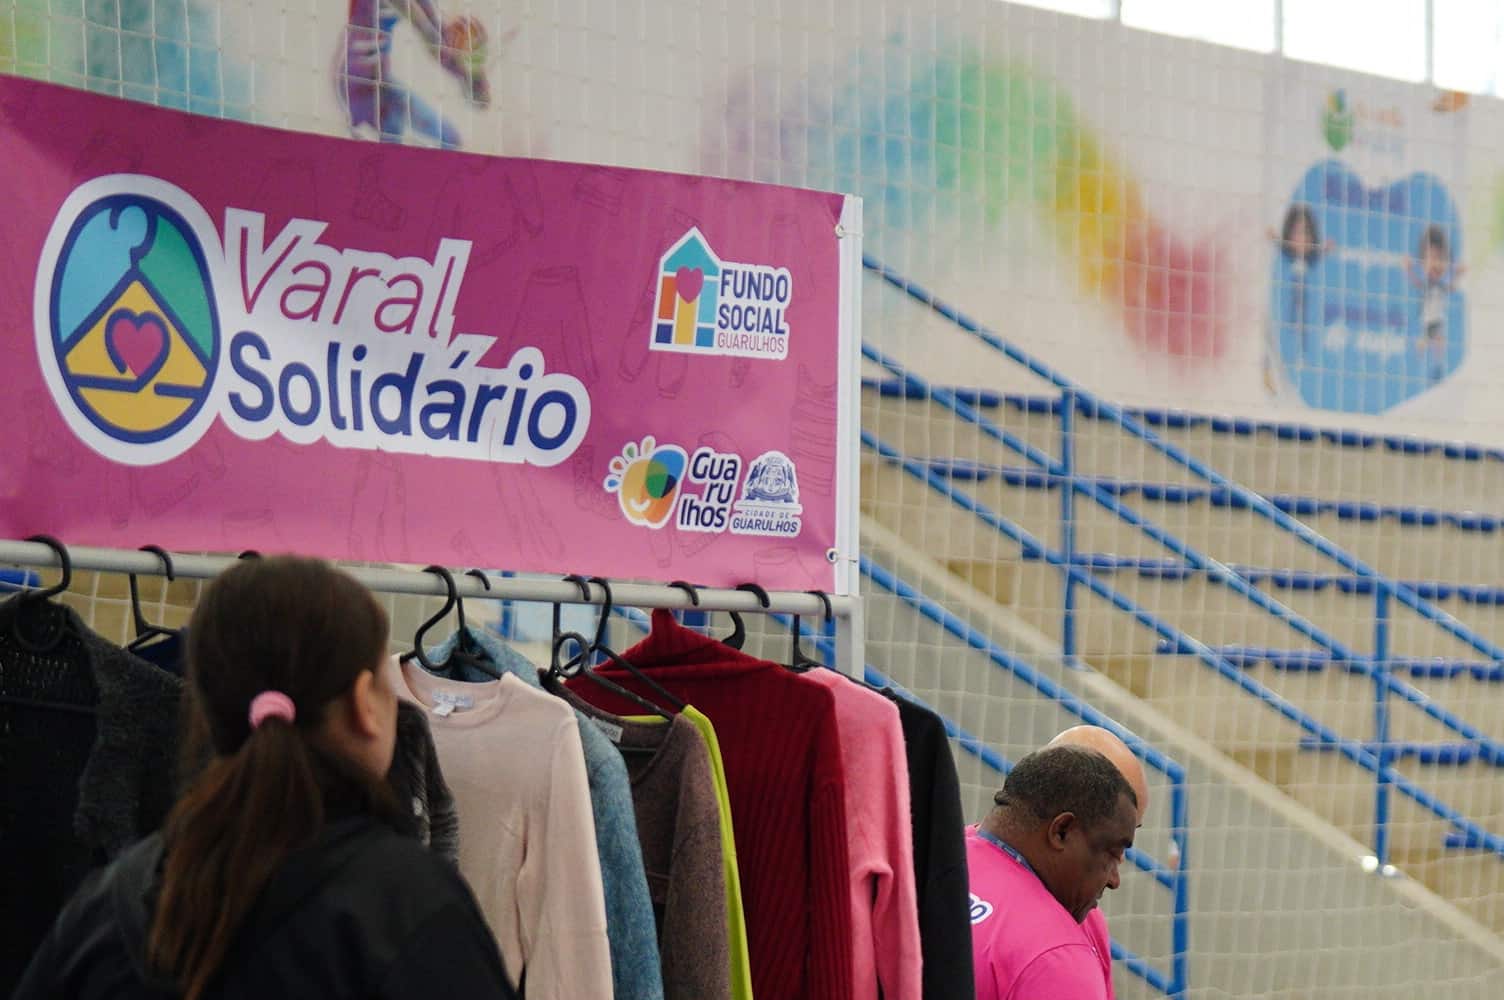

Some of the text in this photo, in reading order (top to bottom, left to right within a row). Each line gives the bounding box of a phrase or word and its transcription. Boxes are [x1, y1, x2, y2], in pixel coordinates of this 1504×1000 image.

[239, 225, 457, 339] Varal
[720, 268, 788, 302] FUNDO
[718, 303, 786, 334] SOCIAL
[717, 331, 785, 353] GUARULHOS
[227, 330, 578, 451] Solidário
[691, 451, 738, 481] Gua
[706, 481, 733, 504] ru
[680, 498, 726, 528] lhos
[733, 517, 798, 533] GUARULHOS
[744, 509, 790, 519] CIDADE DE
